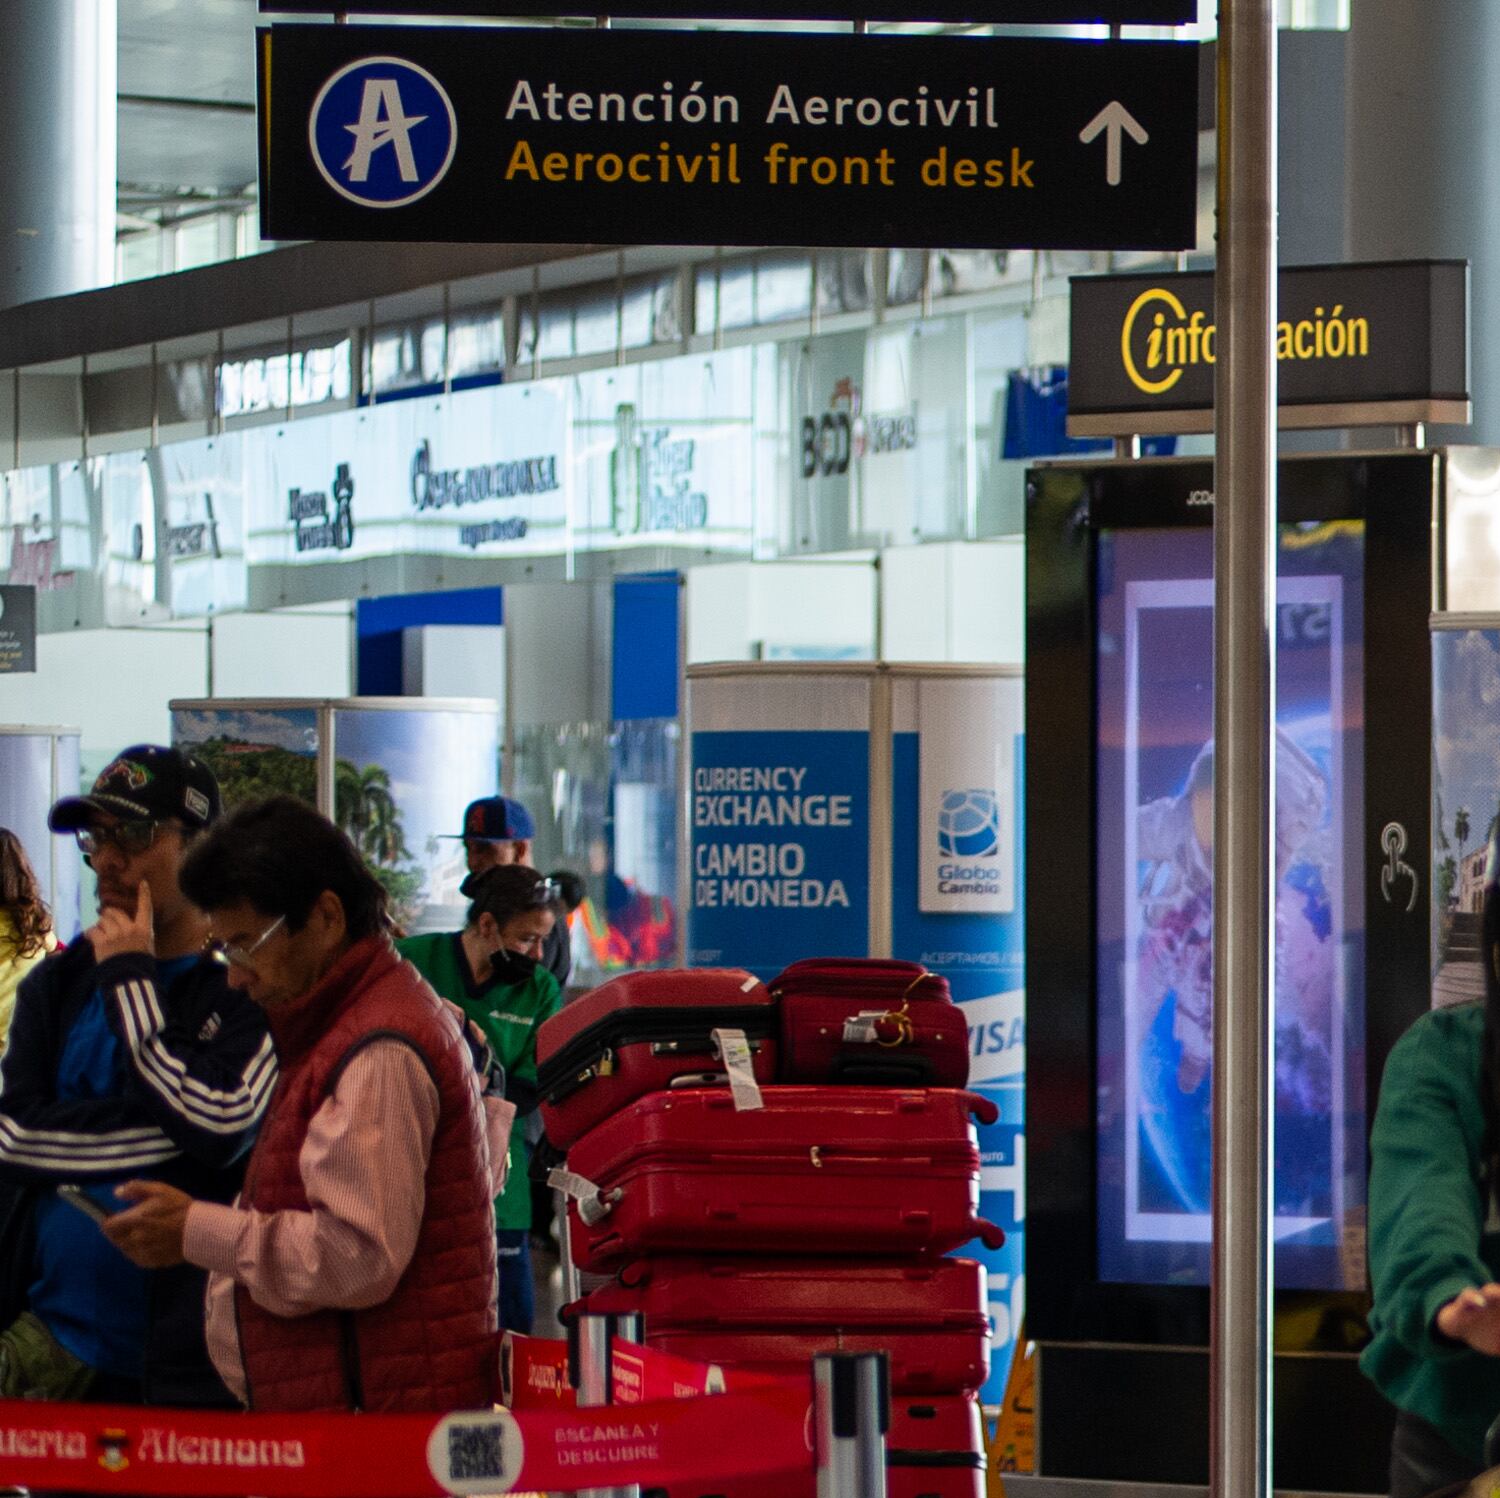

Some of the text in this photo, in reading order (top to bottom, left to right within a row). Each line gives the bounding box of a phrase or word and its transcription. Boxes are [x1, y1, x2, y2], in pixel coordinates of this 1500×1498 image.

[505, 79, 999, 128] Atención Aerocivil
[504, 140, 1035, 189] Aerocivil front desk
[1146, 304, 1369, 369] infoación
[1186, 490, 1215, 506] JCDe
[694, 767, 808, 792] CURRENCY
[694, 795, 852, 827] EXCHANGE
[696, 842, 806, 878] CAMBIO
[937, 863, 1000, 881] Globo
[696, 879, 850, 908] DE MONEDA
[937, 880, 1000, 896] Cambio
[137, 1427, 306, 1467] Alemana
[557, 1444, 660, 1466] DESCUBRE
